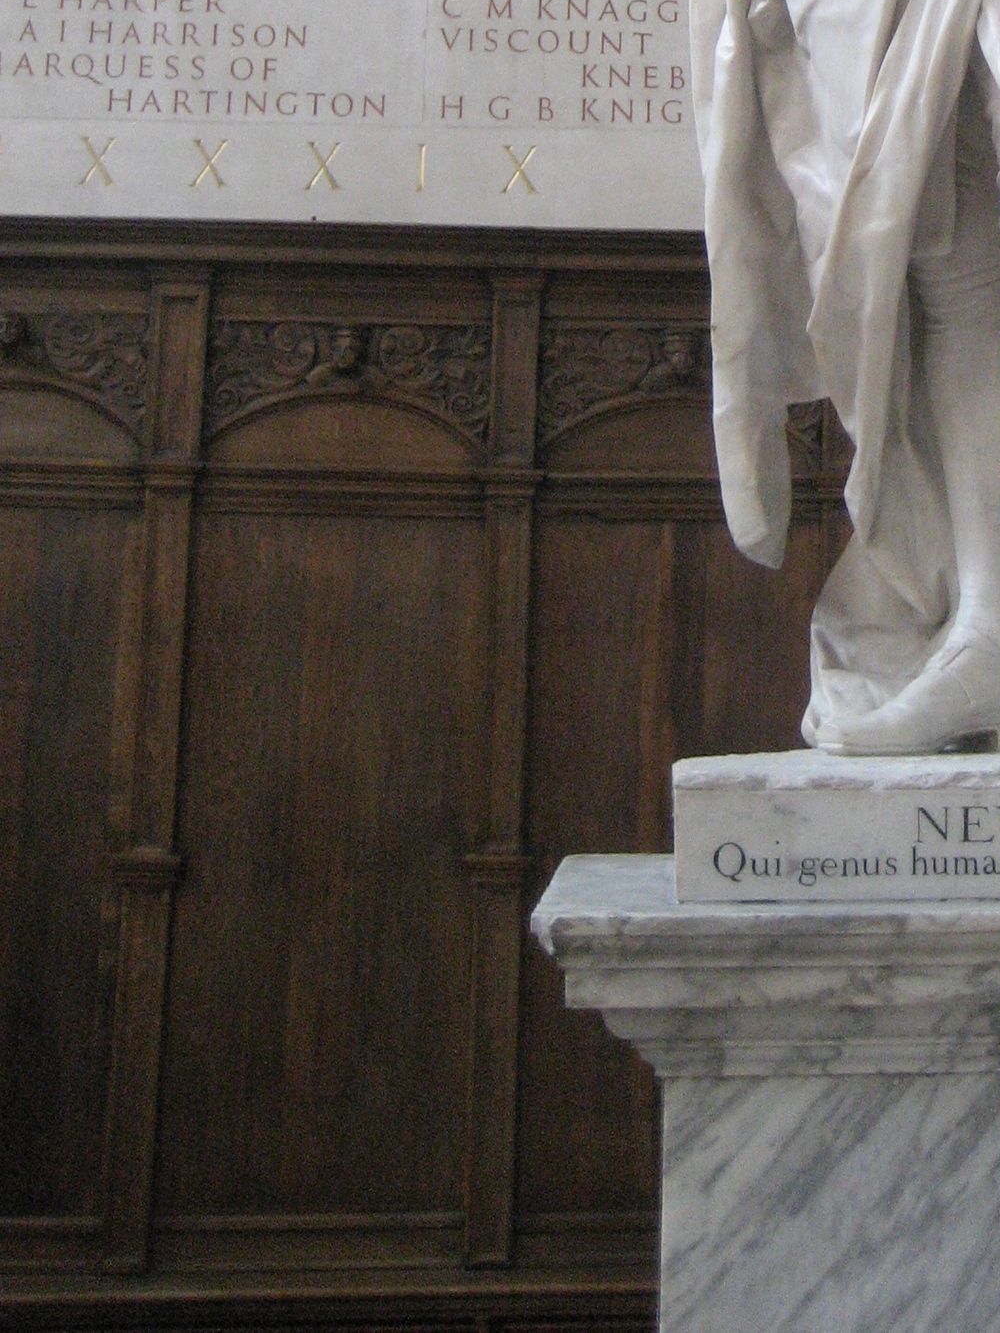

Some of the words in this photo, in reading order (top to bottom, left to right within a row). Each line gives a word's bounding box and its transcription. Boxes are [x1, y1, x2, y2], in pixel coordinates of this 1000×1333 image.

[438, 25, 654, 58] VISCOUNT
[105, 87, 387, 119] HARTINGTON
[713, 841, 783, 880] Qui
[799, 853, 897, 885] genus
